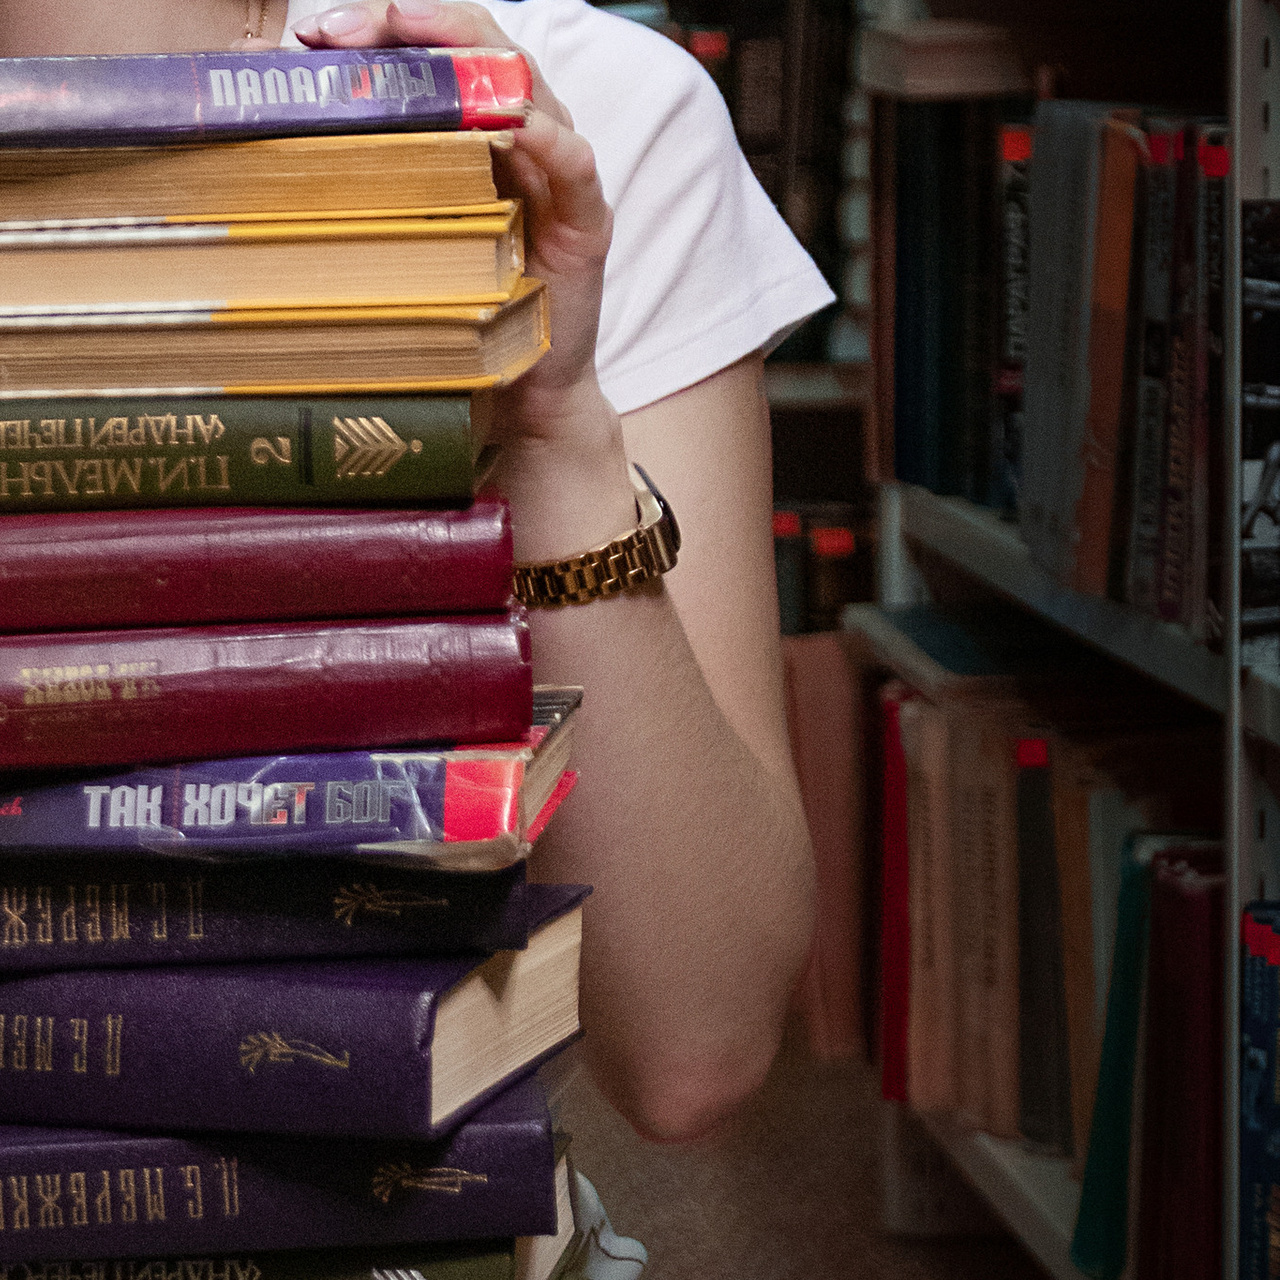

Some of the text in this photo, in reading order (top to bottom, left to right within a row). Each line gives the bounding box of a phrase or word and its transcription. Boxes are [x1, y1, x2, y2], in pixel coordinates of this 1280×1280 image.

[209, 63, 437, 108] ПАЛАДИНЫ
[251, 437, 291, 464] 2
[84, 784, 163, 827] ТАК
[183, 782, 315, 826] ХОЧЕТ
